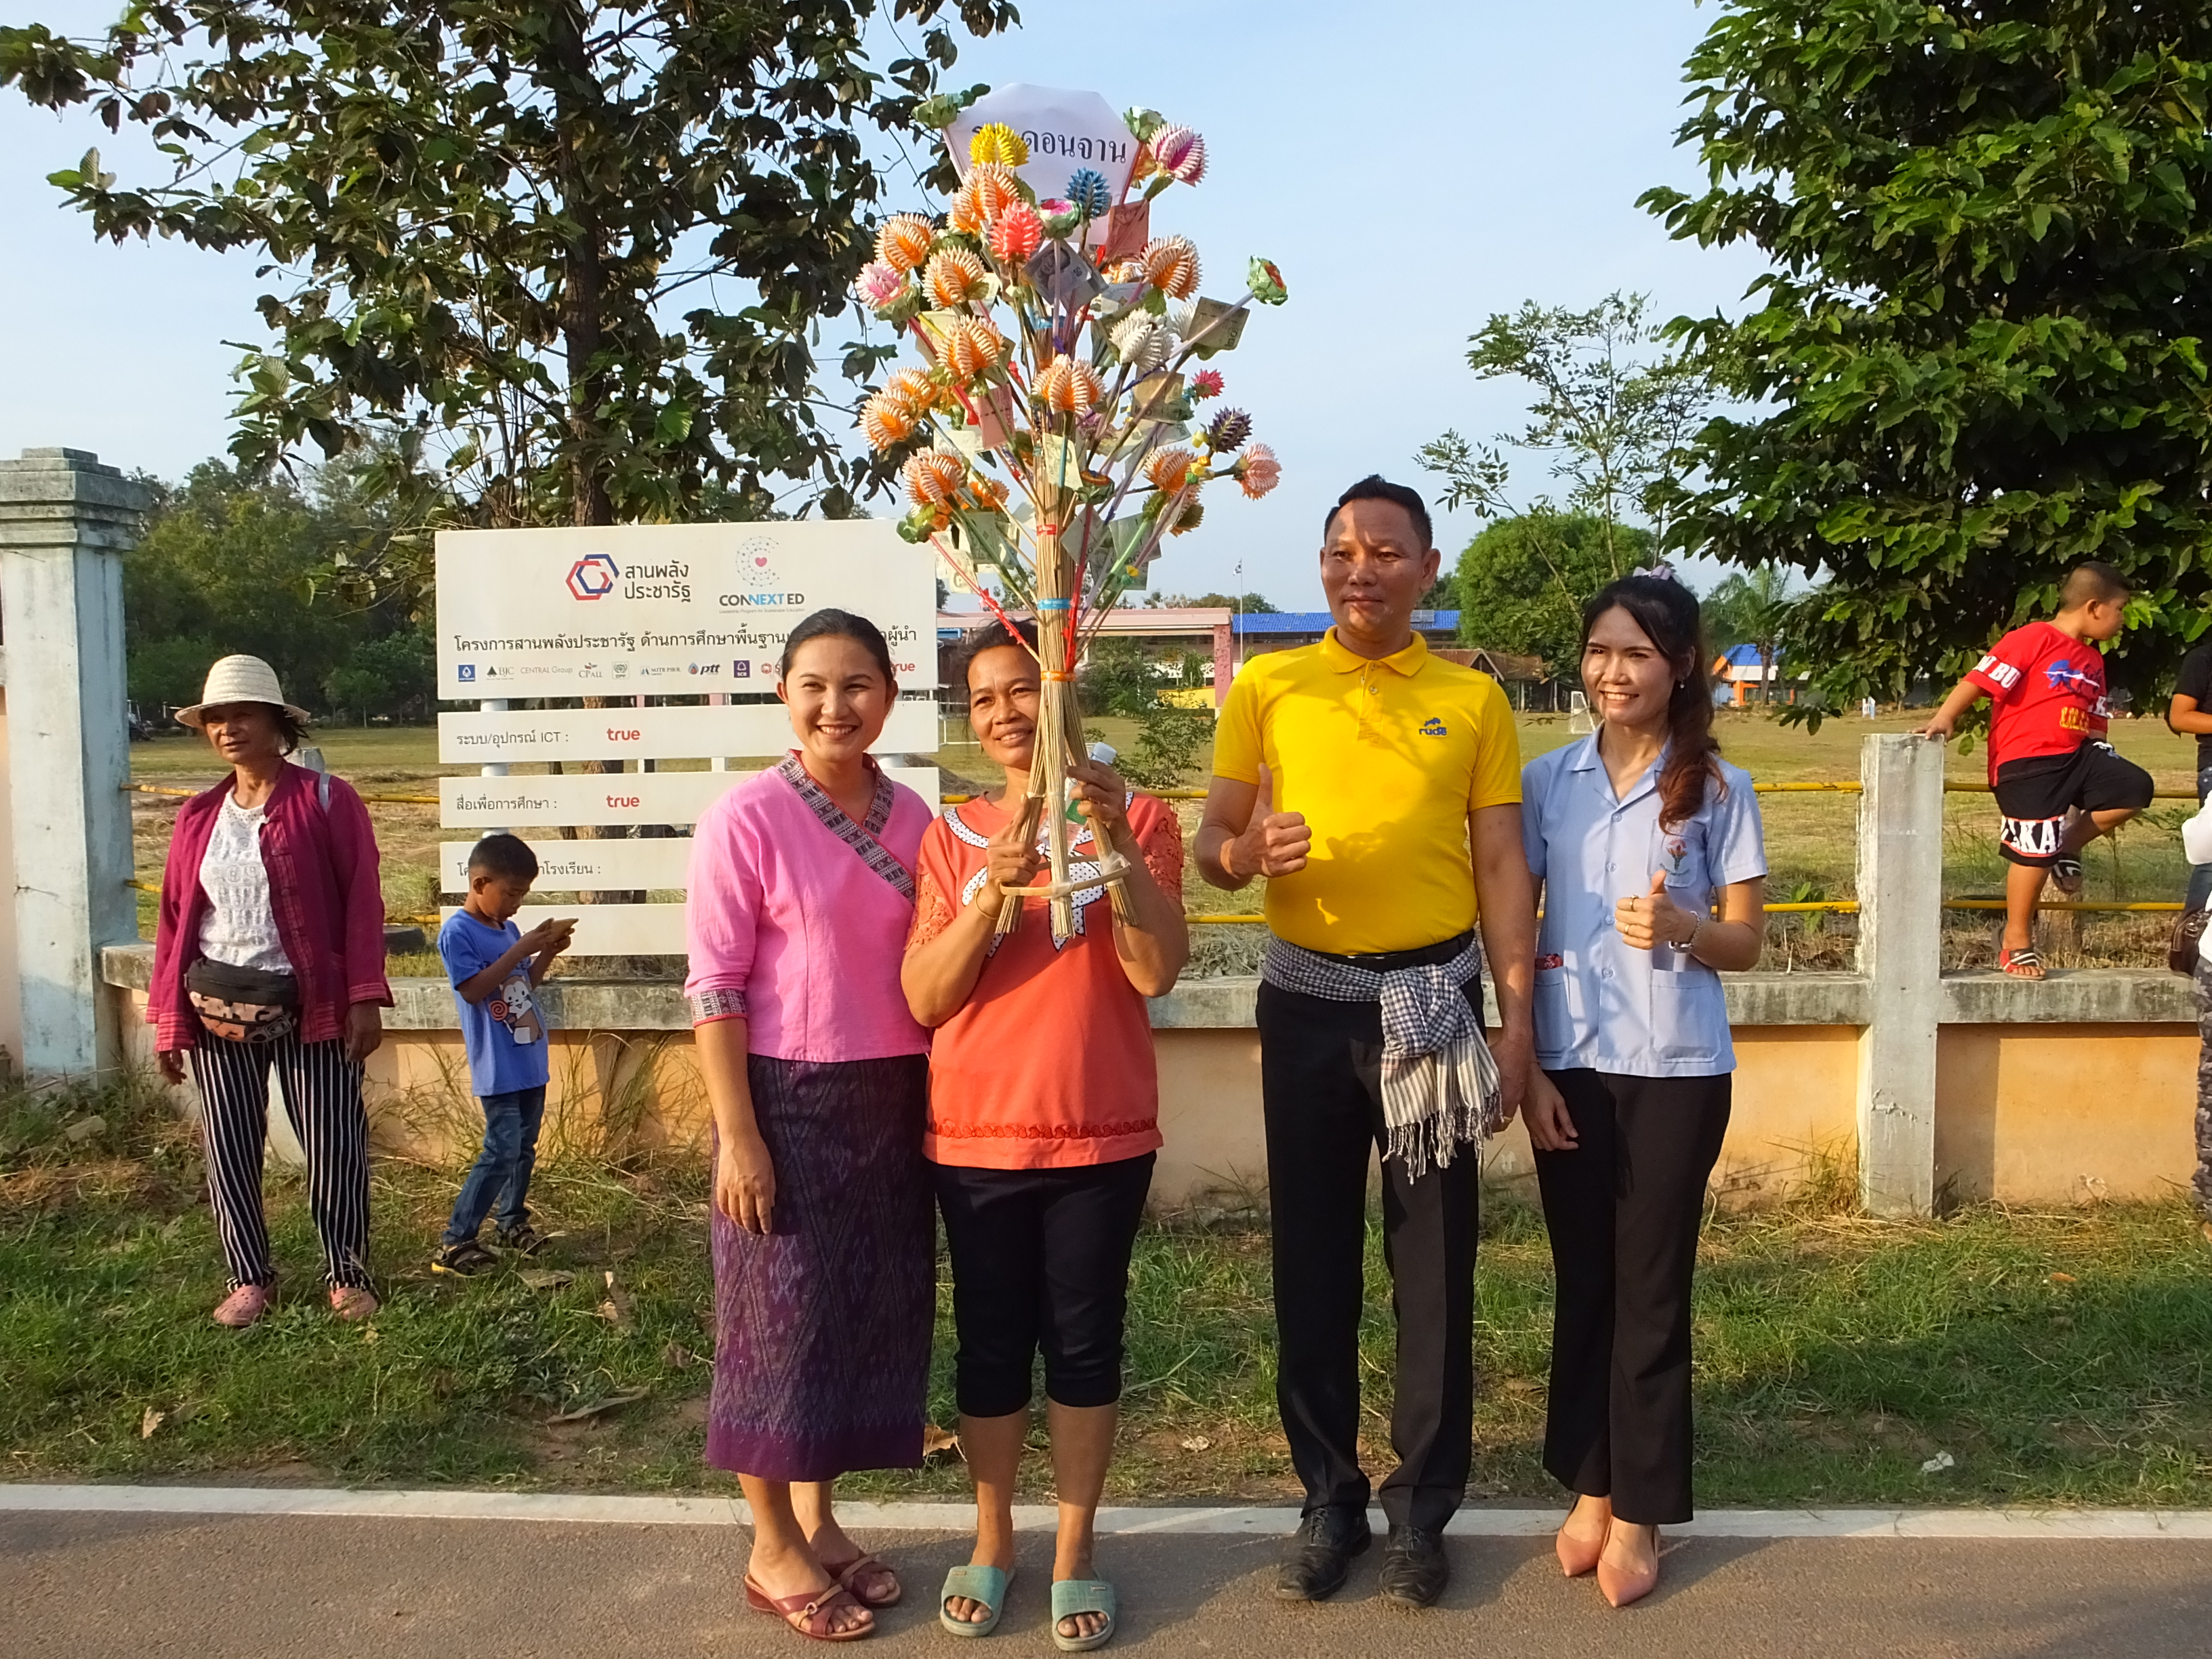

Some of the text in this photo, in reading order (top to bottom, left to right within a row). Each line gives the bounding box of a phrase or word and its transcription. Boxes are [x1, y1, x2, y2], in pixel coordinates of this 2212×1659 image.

[972, 126, 1126, 163] ดอนจาน
[625, 560, 689, 579] สานพลัง
[624, 580, 691, 602] ประชารัฐ
[719, 593, 804, 606] CONNEXT ED
[453, 631, 635, 652] โครงการสานพลังประชารัฐ
[499, 666, 514, 676] BJC
[551, 666, 573, 674] Group
[700, 664, 721, 676] ptt
[893, 663, 916, 672] rue
[607, 728, 641, 741] true
[1418, 726, 1448, 736] rude
[457, 729, 537, 748] ระบบ/อุปกรณ์
[541, 732, 561, 743] ICT
[456, 794, 550, 811] สื่อเพื่อการศึกษา
[606, 795, 640, 808] true
